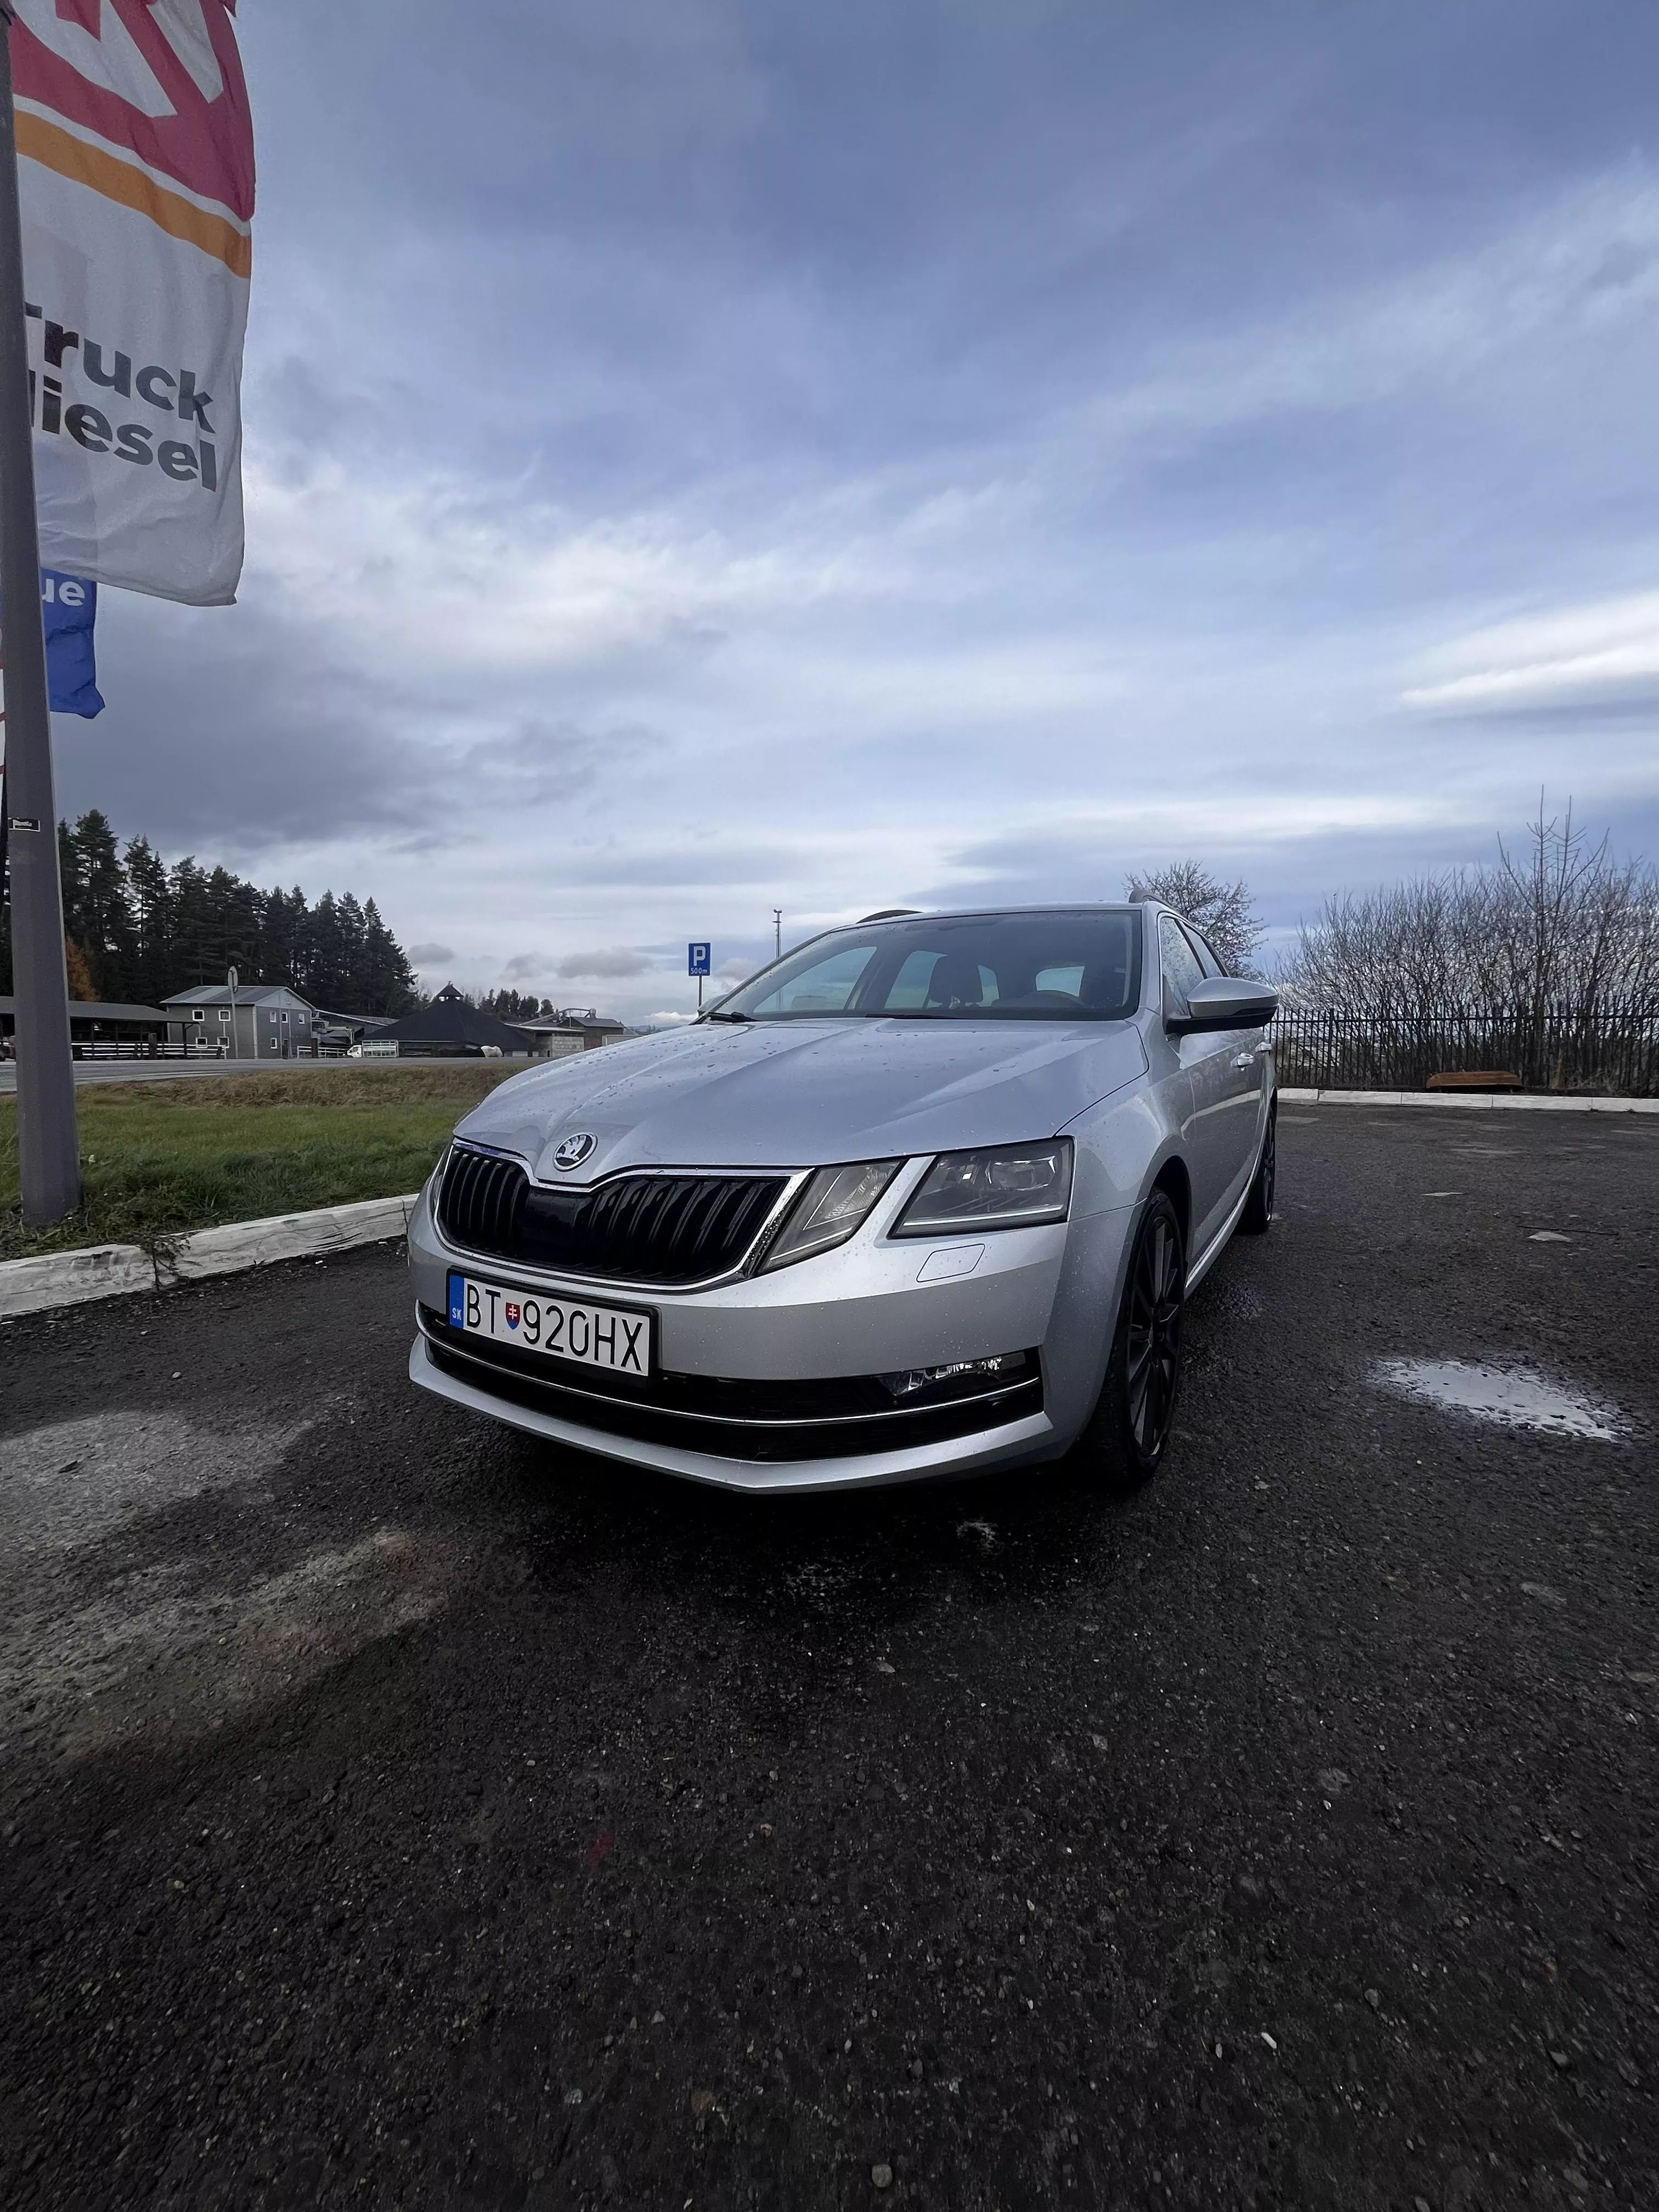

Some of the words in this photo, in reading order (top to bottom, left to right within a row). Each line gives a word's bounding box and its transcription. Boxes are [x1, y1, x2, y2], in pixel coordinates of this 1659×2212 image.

[29, 369, 217, 493] iesel
[693, 946, 706, 966] P
[452, 1307, 462, 1321] SK
